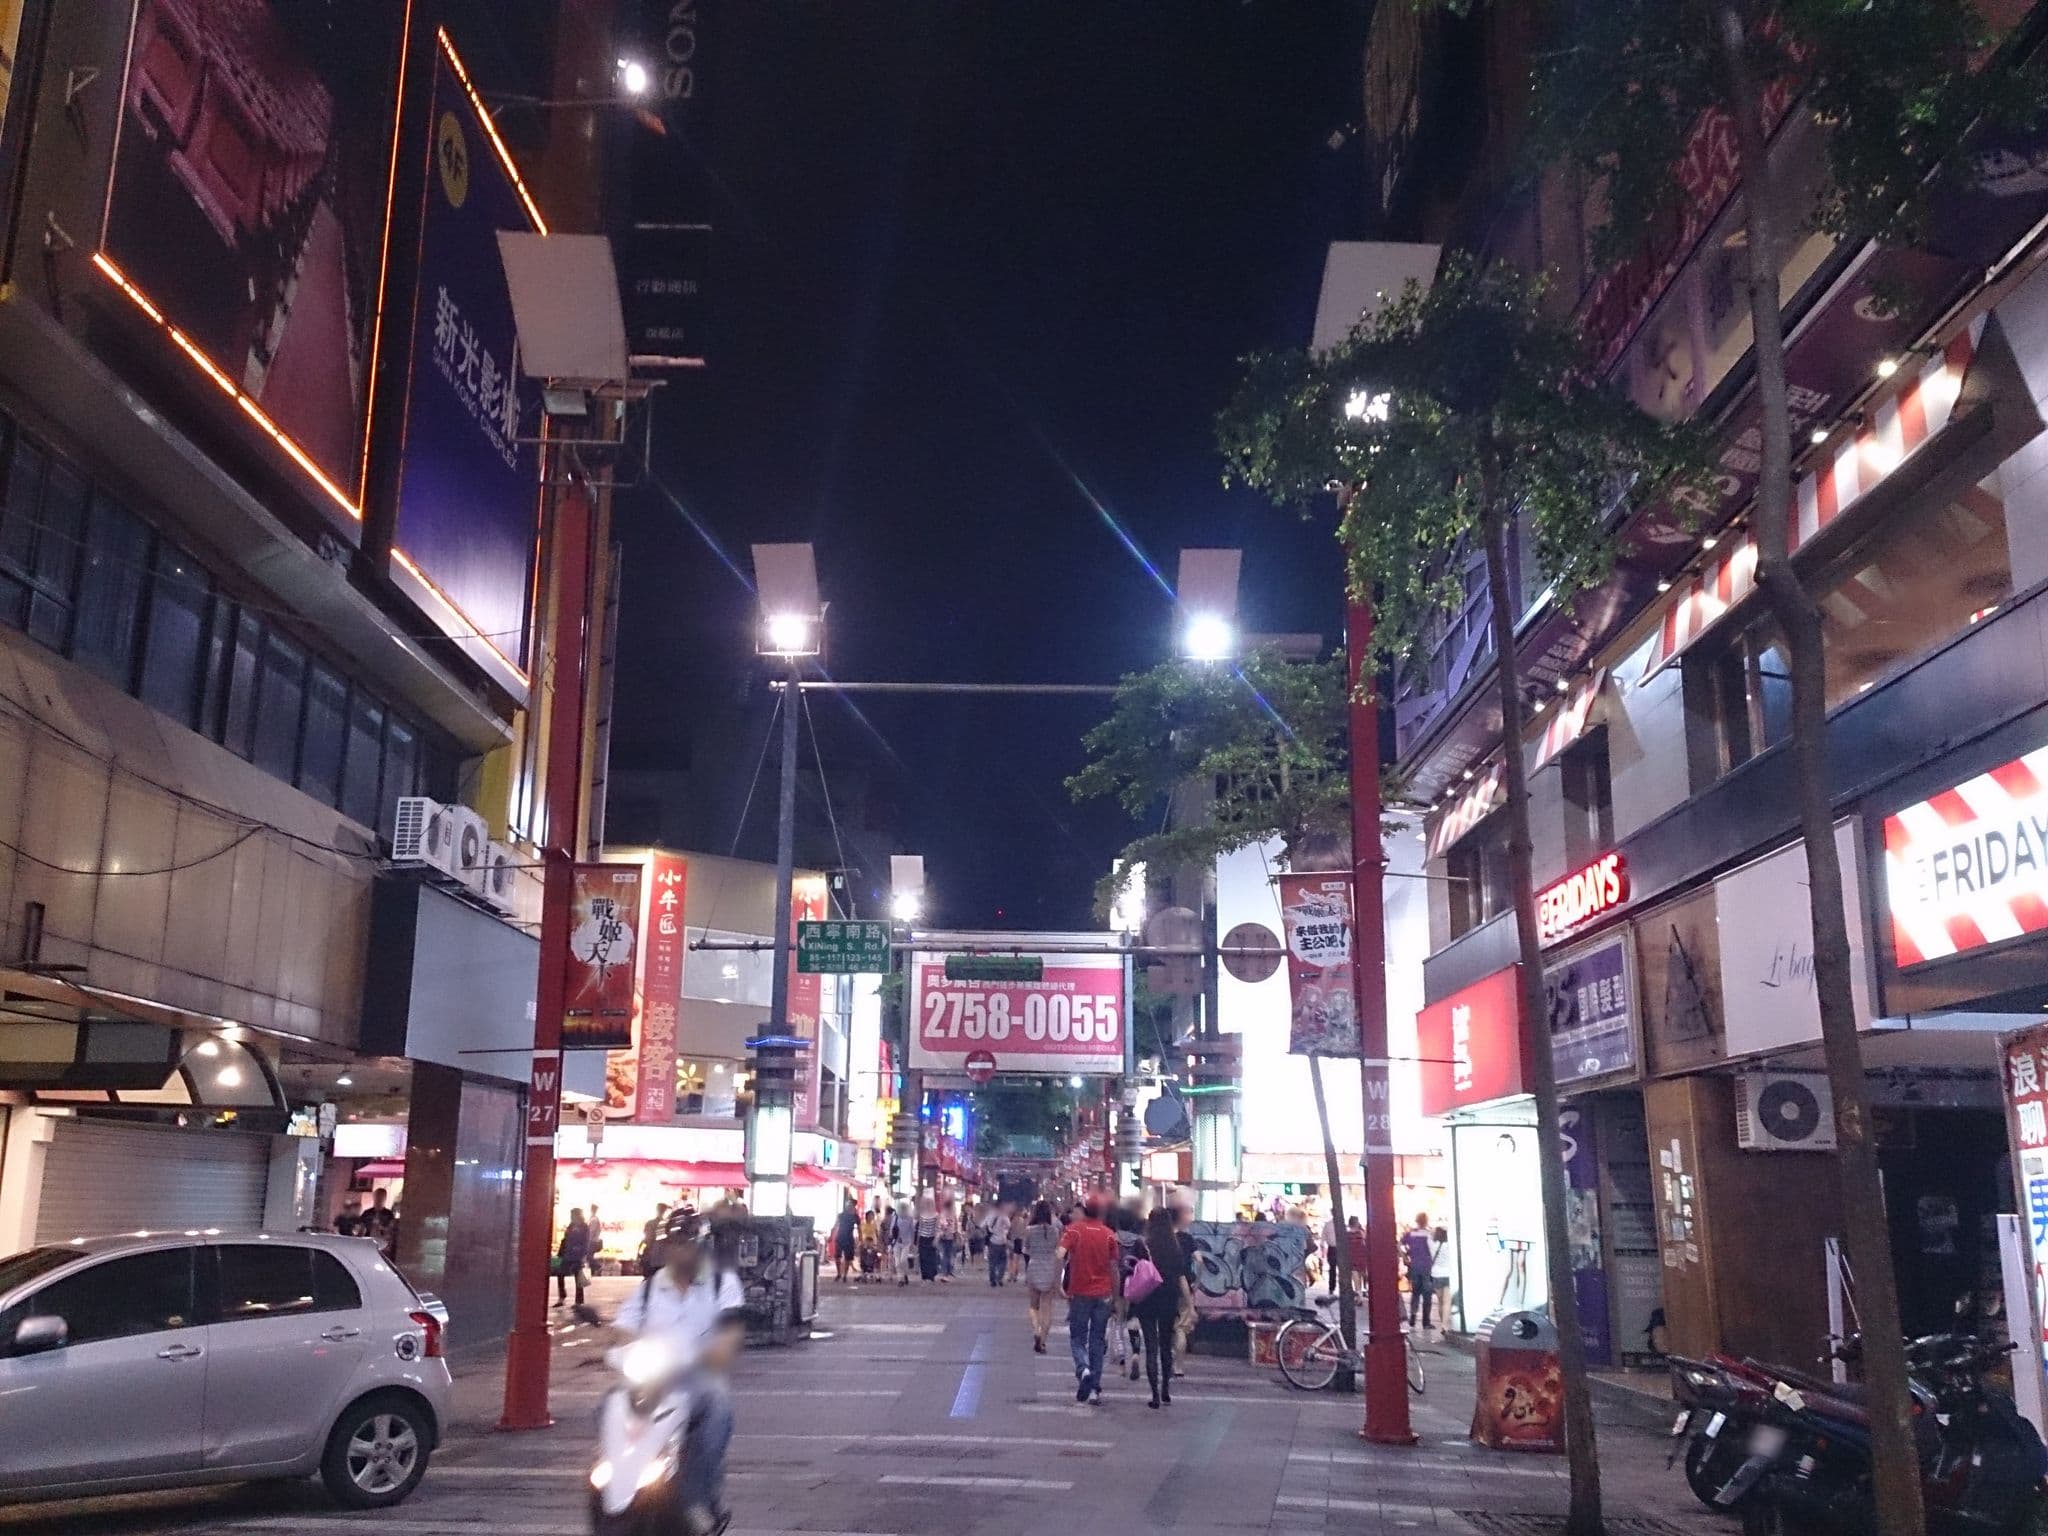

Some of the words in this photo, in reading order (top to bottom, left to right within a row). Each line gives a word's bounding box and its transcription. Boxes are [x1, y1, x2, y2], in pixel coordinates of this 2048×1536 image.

[657, 868, 682, 936] 小牛匠
[1548, 853, 1620, 934] FRIDAYS
[924, 991, 1119, 1043] 2758-0055
[533, 1071, 556, 1092] W
[2010, 1046, 2048, 1098] 浪
[1366, 1080, 1388, 1101] W
[530, 1105, 554, 1122] 27
[1367, 1114, 1391, 1130] 28
